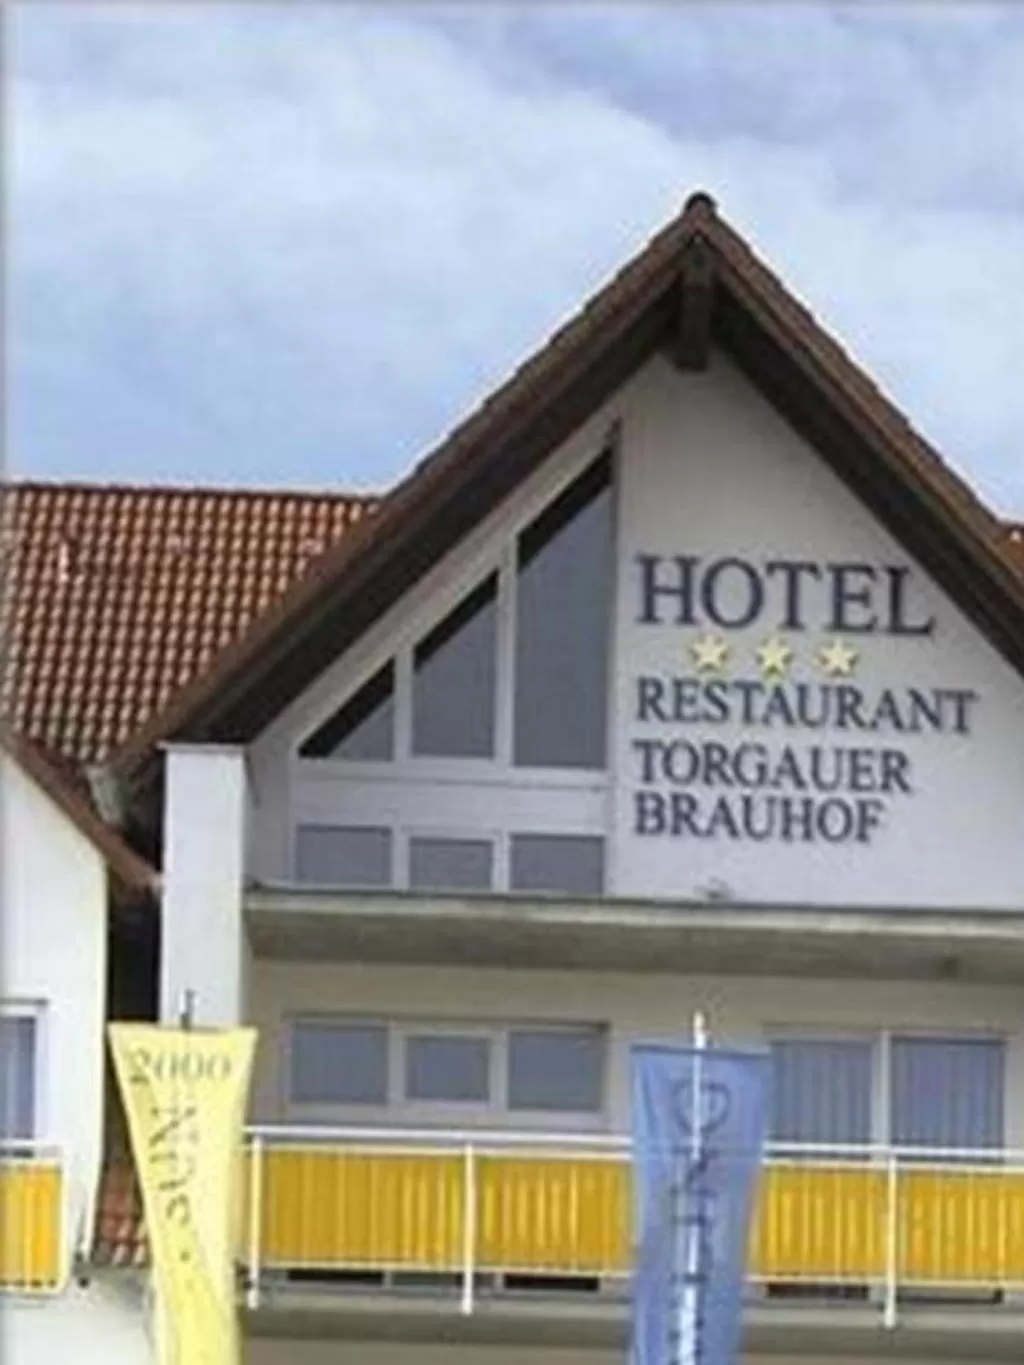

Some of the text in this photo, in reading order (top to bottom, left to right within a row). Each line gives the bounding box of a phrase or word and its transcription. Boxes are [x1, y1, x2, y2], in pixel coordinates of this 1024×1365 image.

[635, 554, 936, 639] HOTEL
[635, 676, 980, 734] RESTAURANT
[631, 738, 912, 795] TORGAUER
[633, 790, 886, 844] BRAUHOF
[129, 1046, 233, 1086] 2000
